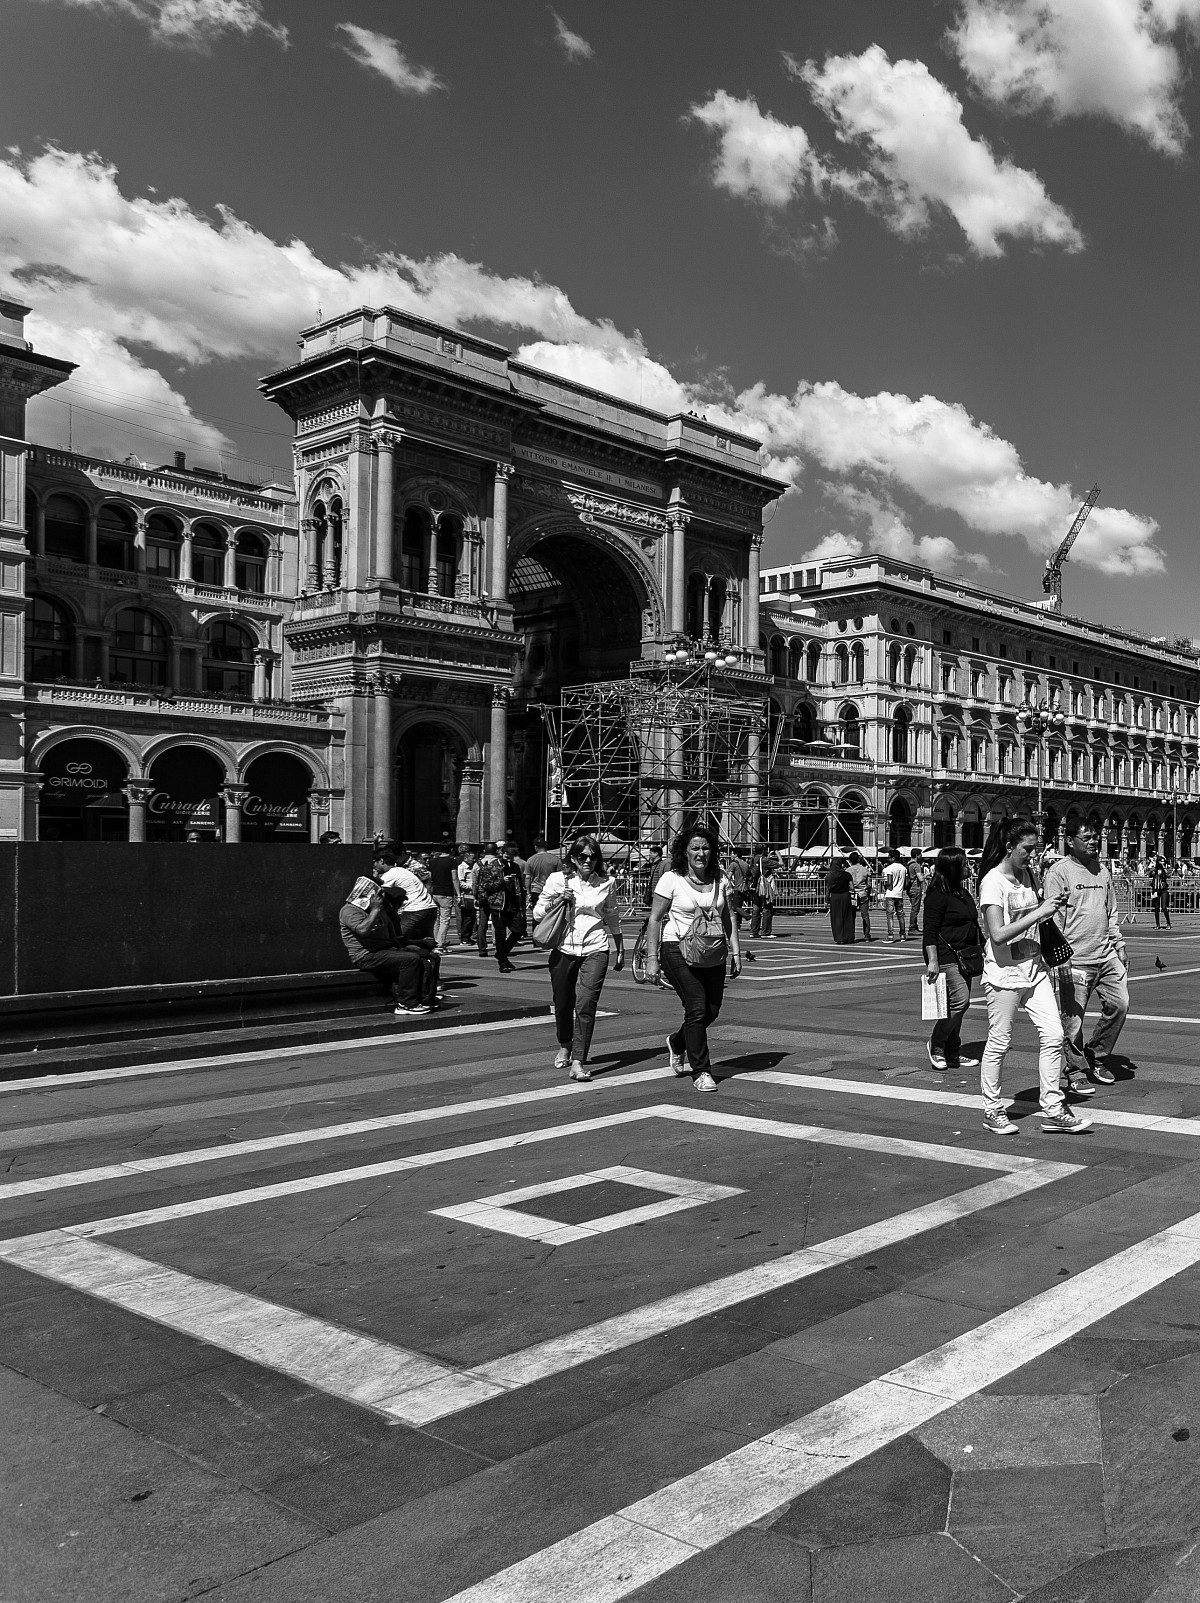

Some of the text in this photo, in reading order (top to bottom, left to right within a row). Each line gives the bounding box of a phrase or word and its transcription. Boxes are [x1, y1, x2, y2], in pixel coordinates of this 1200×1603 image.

[521, 449, 558, 465] VITTORIO
[562, 461, 603, 479] EMANUELE
[624, 479, 656, 494] MILANESI
[48, 776, 109, 789] GRIMOLDI
[148, 792, 212, 814] Currado
[242, 795, 299, 817] Currado
